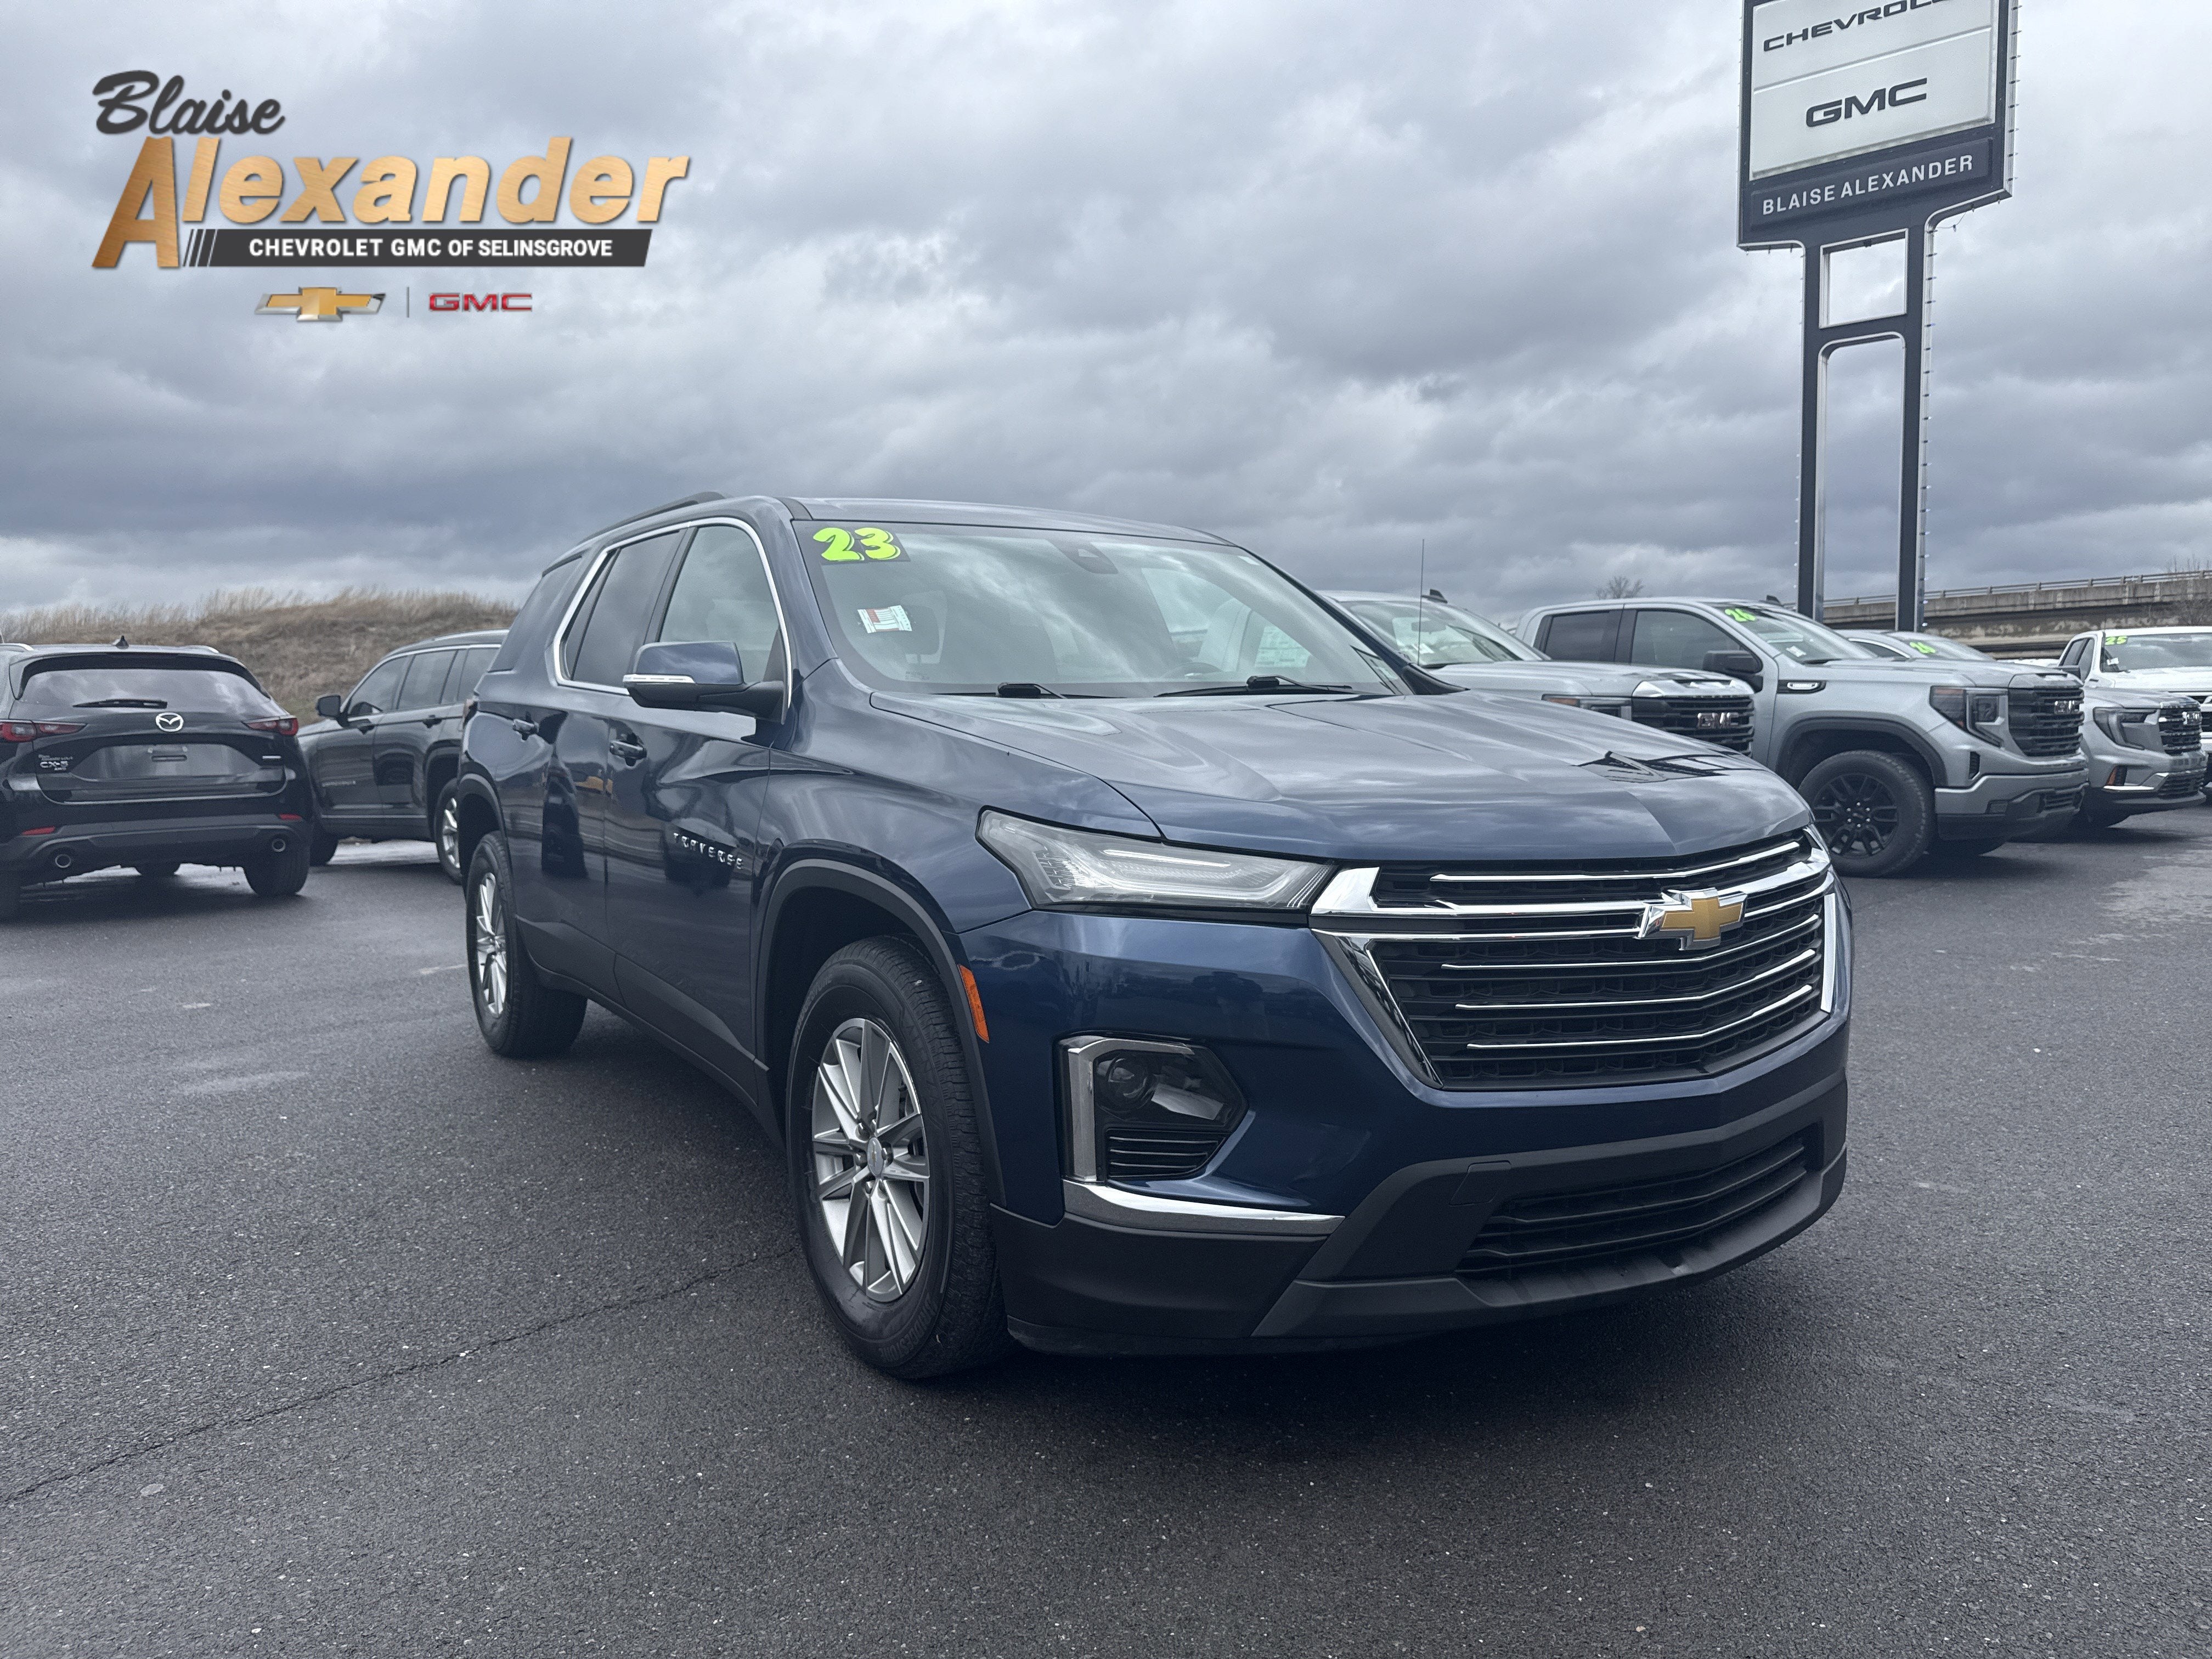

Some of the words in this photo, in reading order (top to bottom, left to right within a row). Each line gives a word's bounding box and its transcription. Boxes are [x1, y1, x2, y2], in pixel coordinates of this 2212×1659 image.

[1764, 0, 1946, 52] CHEVROL
[1805, 77, 1927, 128] GMC
[1763, 184, 1836, 215] BLAISE
[1841, 155, 1973, 199] ALEXANDER
[812, 527, 901, 561] 23
[2104, 636, 2128, 646] 25
[1697, 712, 1740, 730] GMC
[673, 832, 744, 870] TRAVERSE
